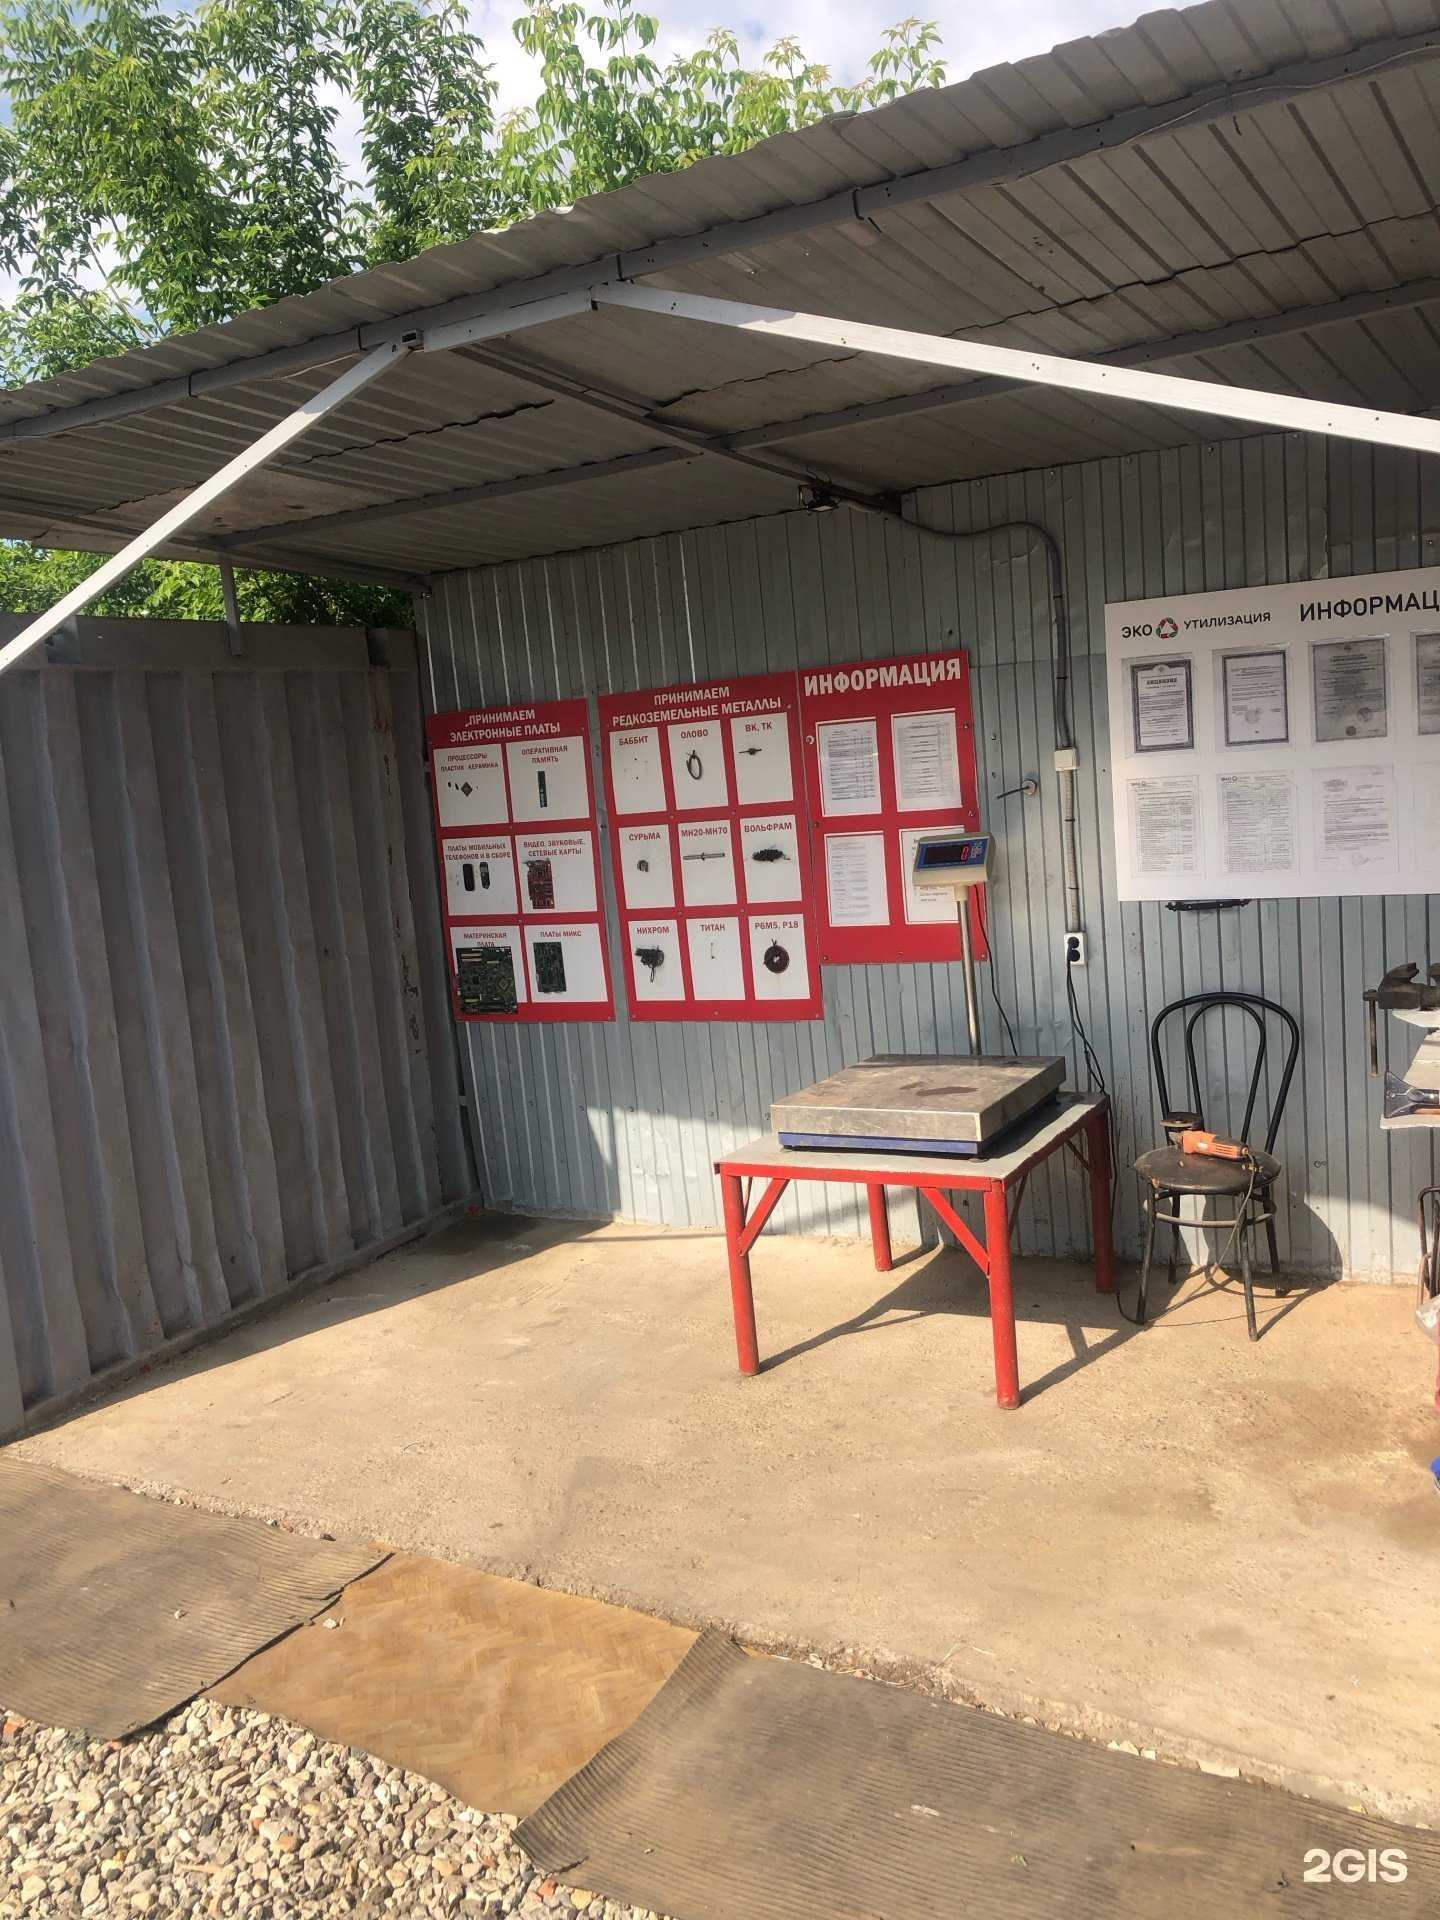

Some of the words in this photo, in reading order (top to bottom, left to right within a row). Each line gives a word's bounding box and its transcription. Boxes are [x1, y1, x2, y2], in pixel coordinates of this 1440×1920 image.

[1300, 590, 1440, 622] ИНФОРМАЦ
[1121, 623, 1153, 639] ЭКО
[1183, 611, 1271, 631] УТИЛИЗАЦИЯ
[804, 658, 961, 697] ИНФОРМАЦИЯ
[654, 687, 730, 706] ПРИНИМАЕМ
[469, 709, 536, 726] ПРИНИМАЕМ
[612, 705, 719, 727] РЕДКОЗЕМЕЛЬНЫЕ
[721, 697, 781, 715] МЕТАЛЛЫ
[450, 726, 522, 743] ЭЛЕКТРОННЫЕ
[524, 722, 560, 735] ПЛАТЫ
[745, 723, 759, 733] ВК,
[759, 721, 773, 731] ТК
[680, 728, 709, 739] ОЛОВО
[618, 735, 649, 746] БАББИТ
[521, 745, 568, 756] ОПЕРАТИВНАЯ
[447, 752, 488, 762] ПРОЦЕССОРЫ
[531, 756, 559, 765] ПАМЯТЬ
[681, 827, 728, 838] МН20-МН70
[744, 822, 792, 833] ВОЛЬФРАМ
[628, 832, 661, 841] СУРЬМА
[469, 843, 506, 851] МОБИЛЬНЫХ
[528, 849, 558, 857] СЕТЕВЫЕ
[559, 847, 582, 856] КАРТЫ
[445, 852, 480, 861] ТЕЛЕФОНОВ
[491, 851, 511, 859] СБОРЕ
[700, 923, 726, 932] ТИТАН
[782, 920, 799, 929] Р18
[636, 926, 670, 935] НИХРОМ
